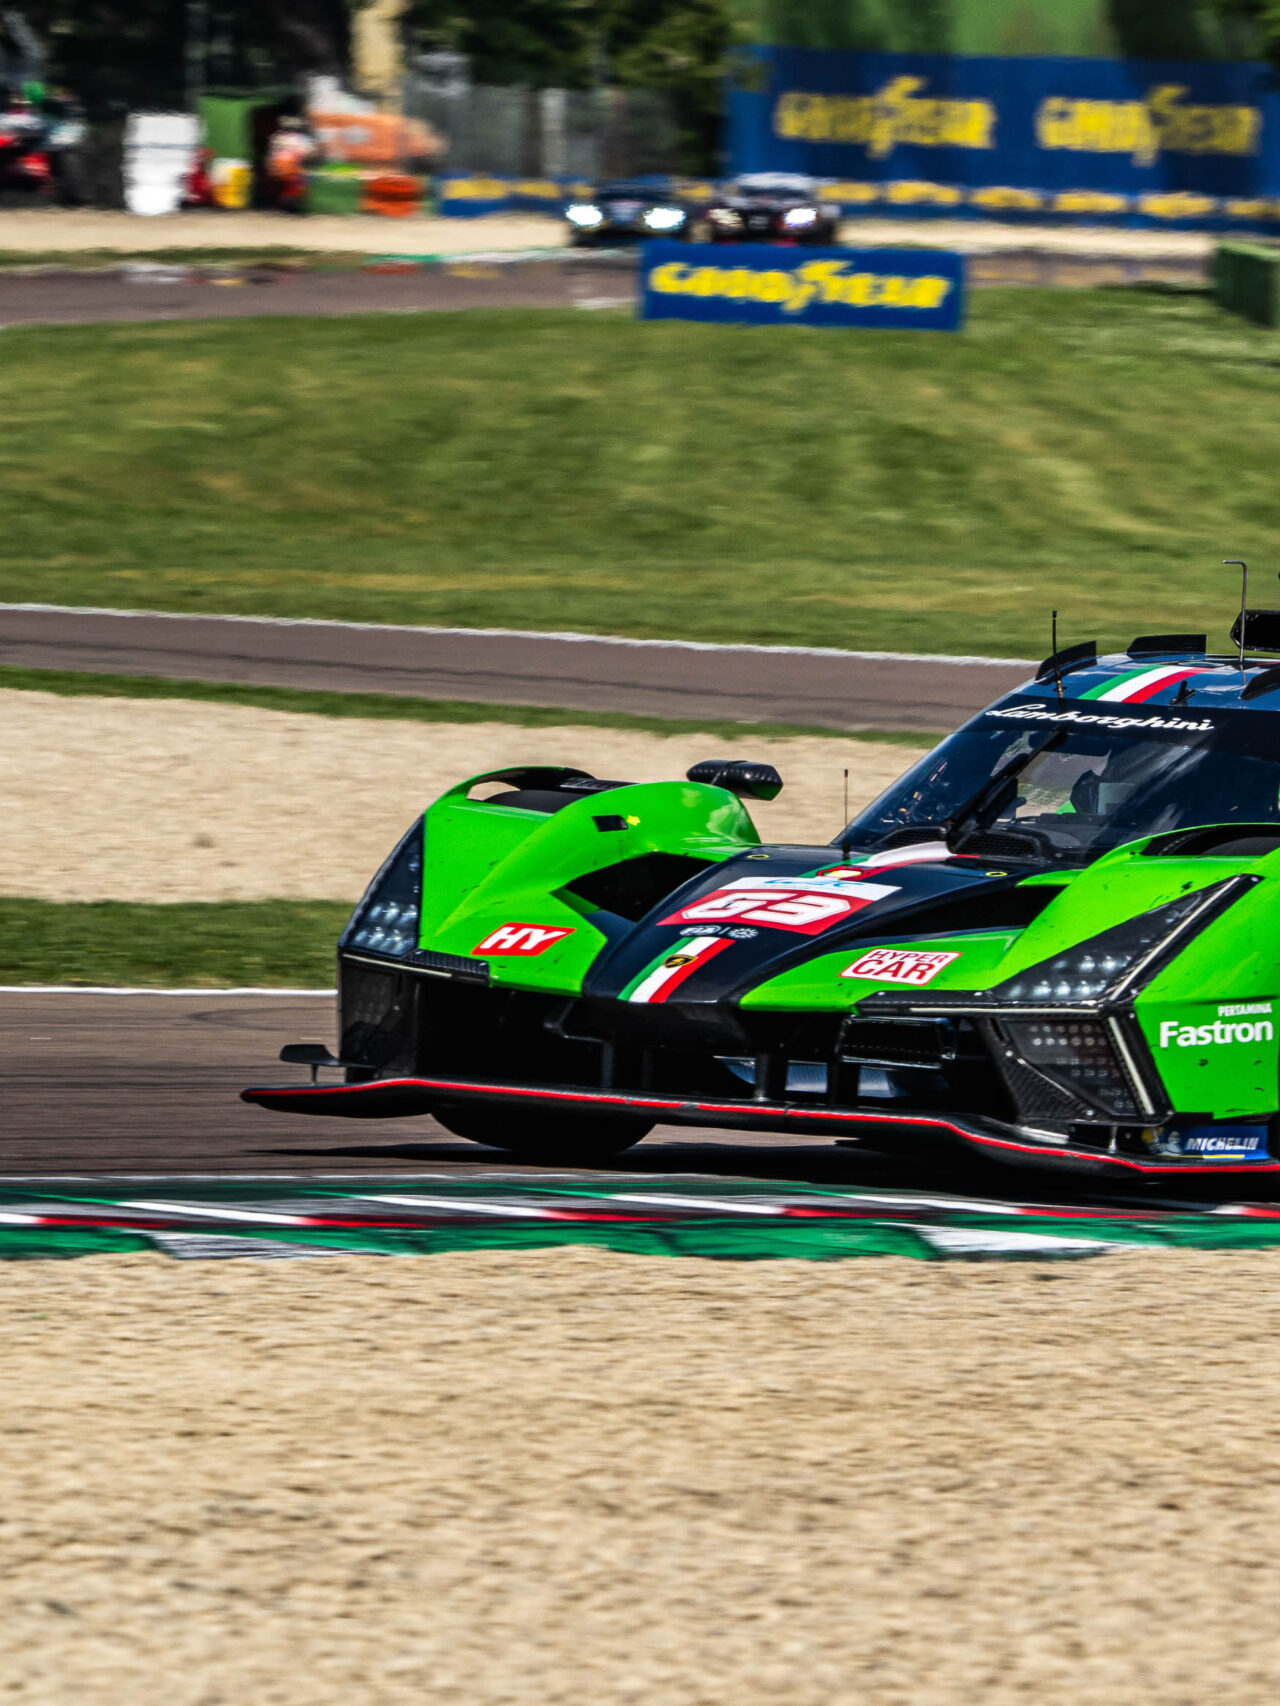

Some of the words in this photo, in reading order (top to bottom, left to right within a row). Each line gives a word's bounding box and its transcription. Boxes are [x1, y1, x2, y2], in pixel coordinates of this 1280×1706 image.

[650, 260, 952, 314] GOODYEAR
[985, 703, 1214, 731] Lamborghini
[681, 891, 852, 926] 63
[480, 926, 567, 950] HY
[869, 950, 949, 963] HYPER
[852, 960, 935, 980] CAR
[1218, 1003, 1272, 1017] PERTAMINA
[1160, 1020, 1274, 1048] Fastron
[1185, 1137, 1259, 1151] MICHELIN
